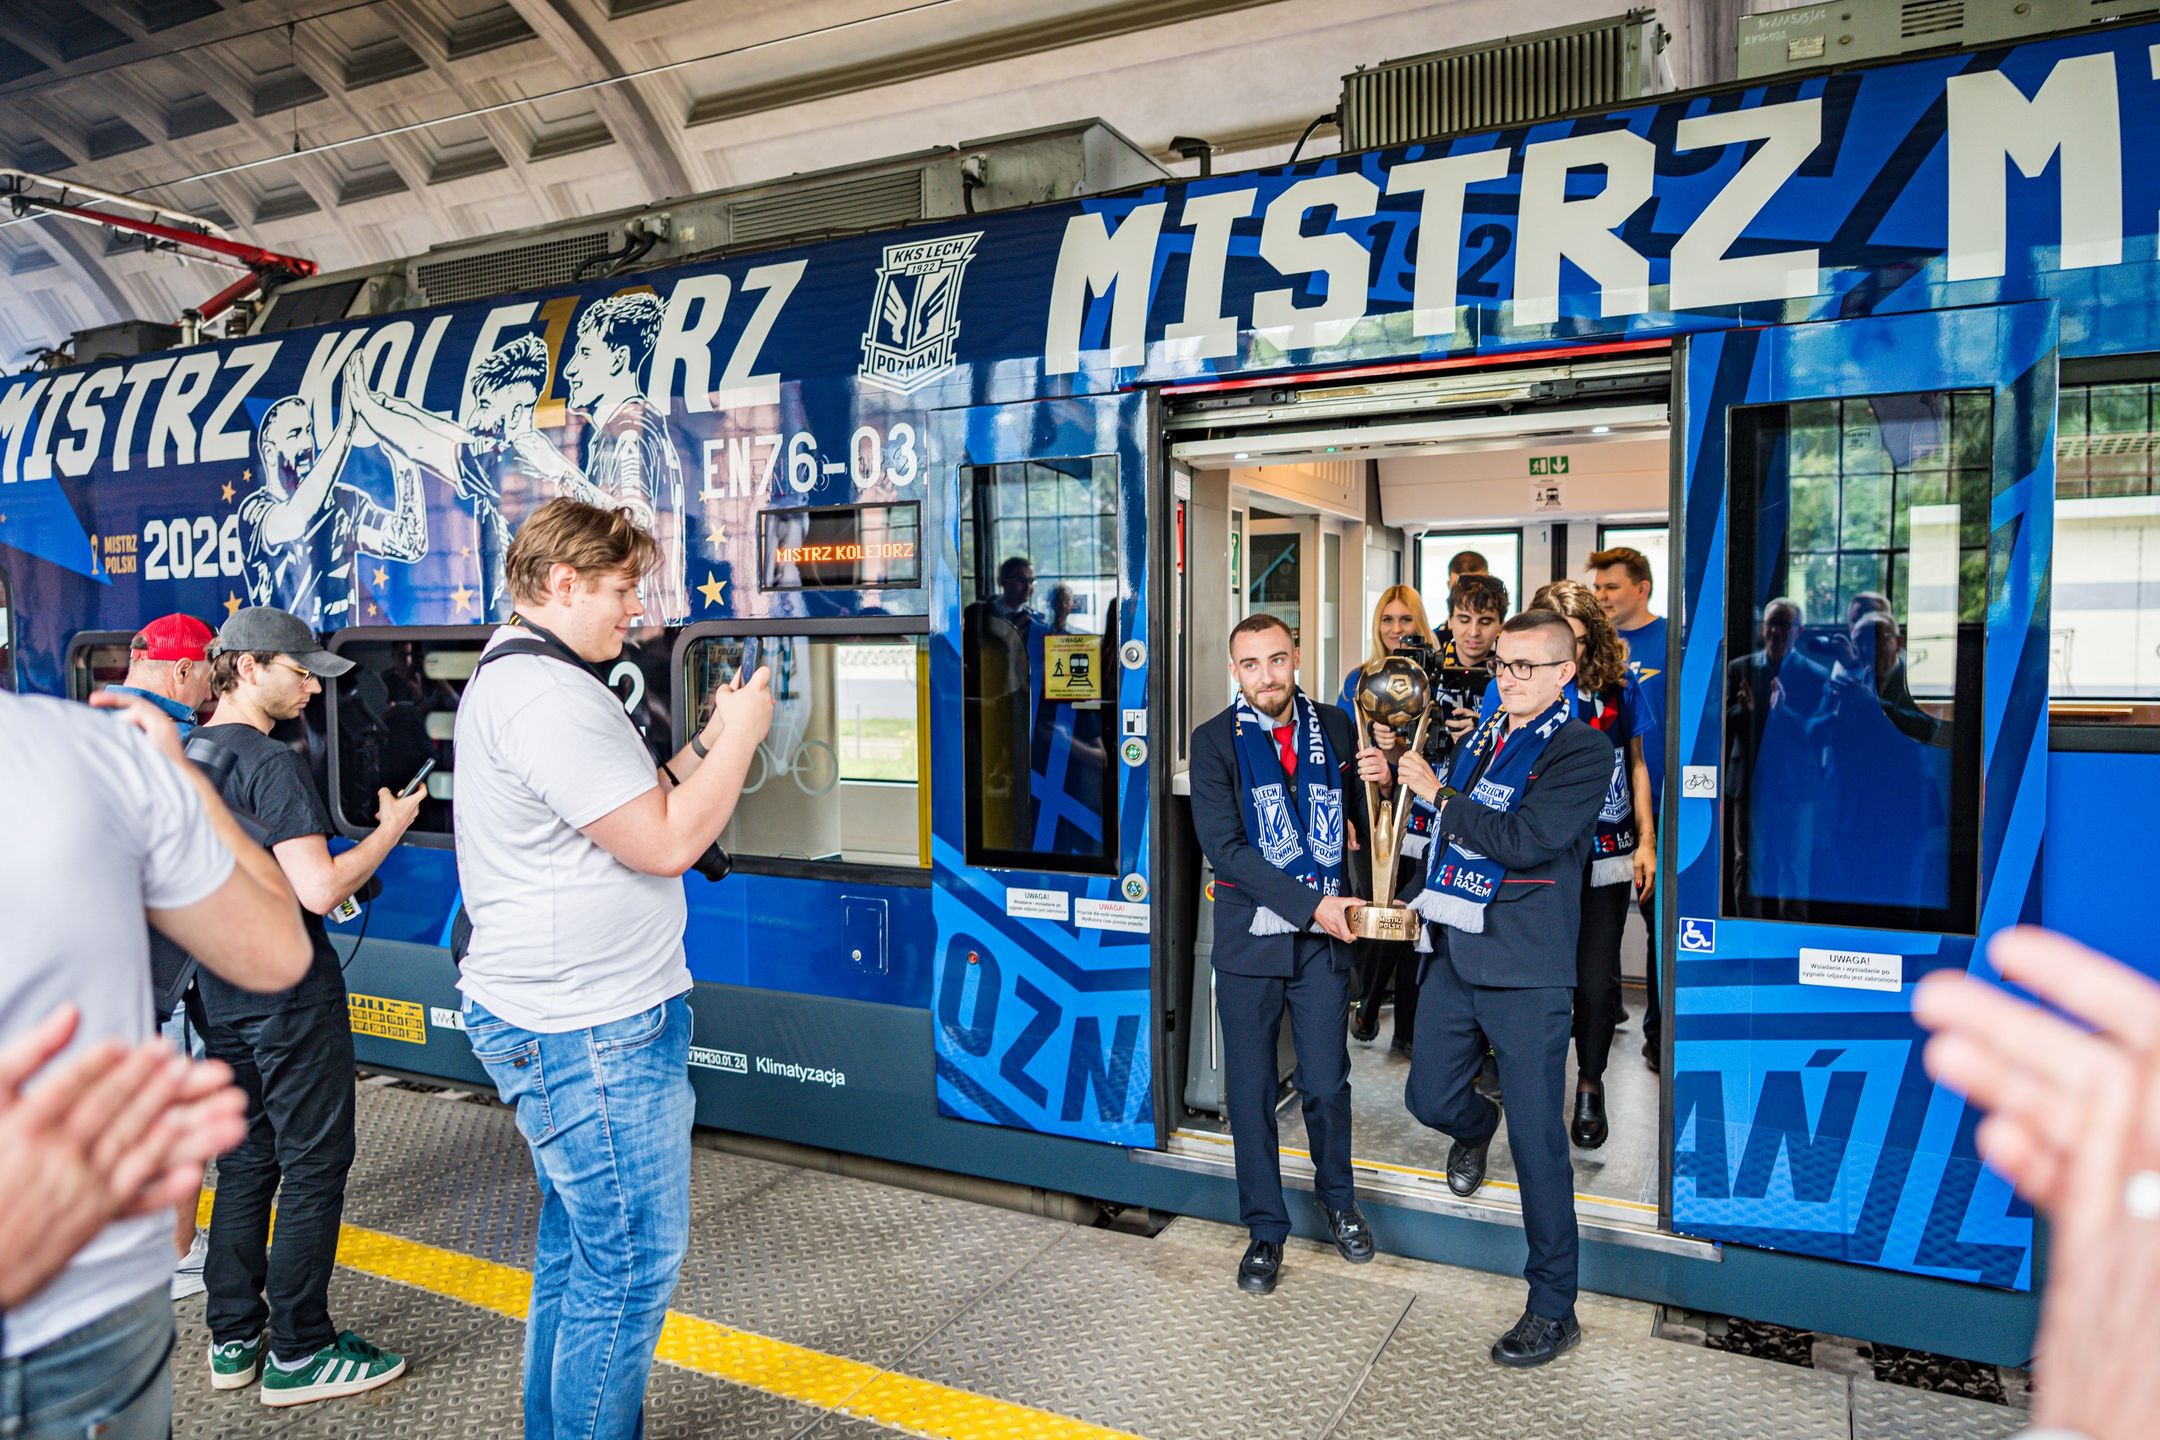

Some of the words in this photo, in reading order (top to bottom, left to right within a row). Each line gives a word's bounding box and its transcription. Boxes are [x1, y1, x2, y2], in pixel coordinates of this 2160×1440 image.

[1045, 97, 1822, 376] MISTRZ
[1947, 45, 2160, 282] M
[893, 247, 924, 264] KKS
[926, 241, 965, 258] LECH
[911, 262, 936, 274] 1922
[876, 345, 938, 378] POZNAŃ
[0, 340, 283, 484] MISTRZ
[702, 421, 928, 500] EN76-03
[104, 534, 138, 554] MISTRZ
[143, 513, 244, 581] 2026
[776, 546, 832, 563] MISTRZ
[836, 542, 914, 560] KOLEJORZ
[105, 554, 137, 574] POLSKI
[1455, 867, 1485, 885] LAT
[1024, 891, 1050, 901] UWAGA!
[1453, 877, 1492, 898] RAZEM
[1098, 903, 1126, 912] UWAGA!
[1829, 953, 1871, 966] UWAGA!
[755, 1056, 846, 1088] Klimatyzacja
